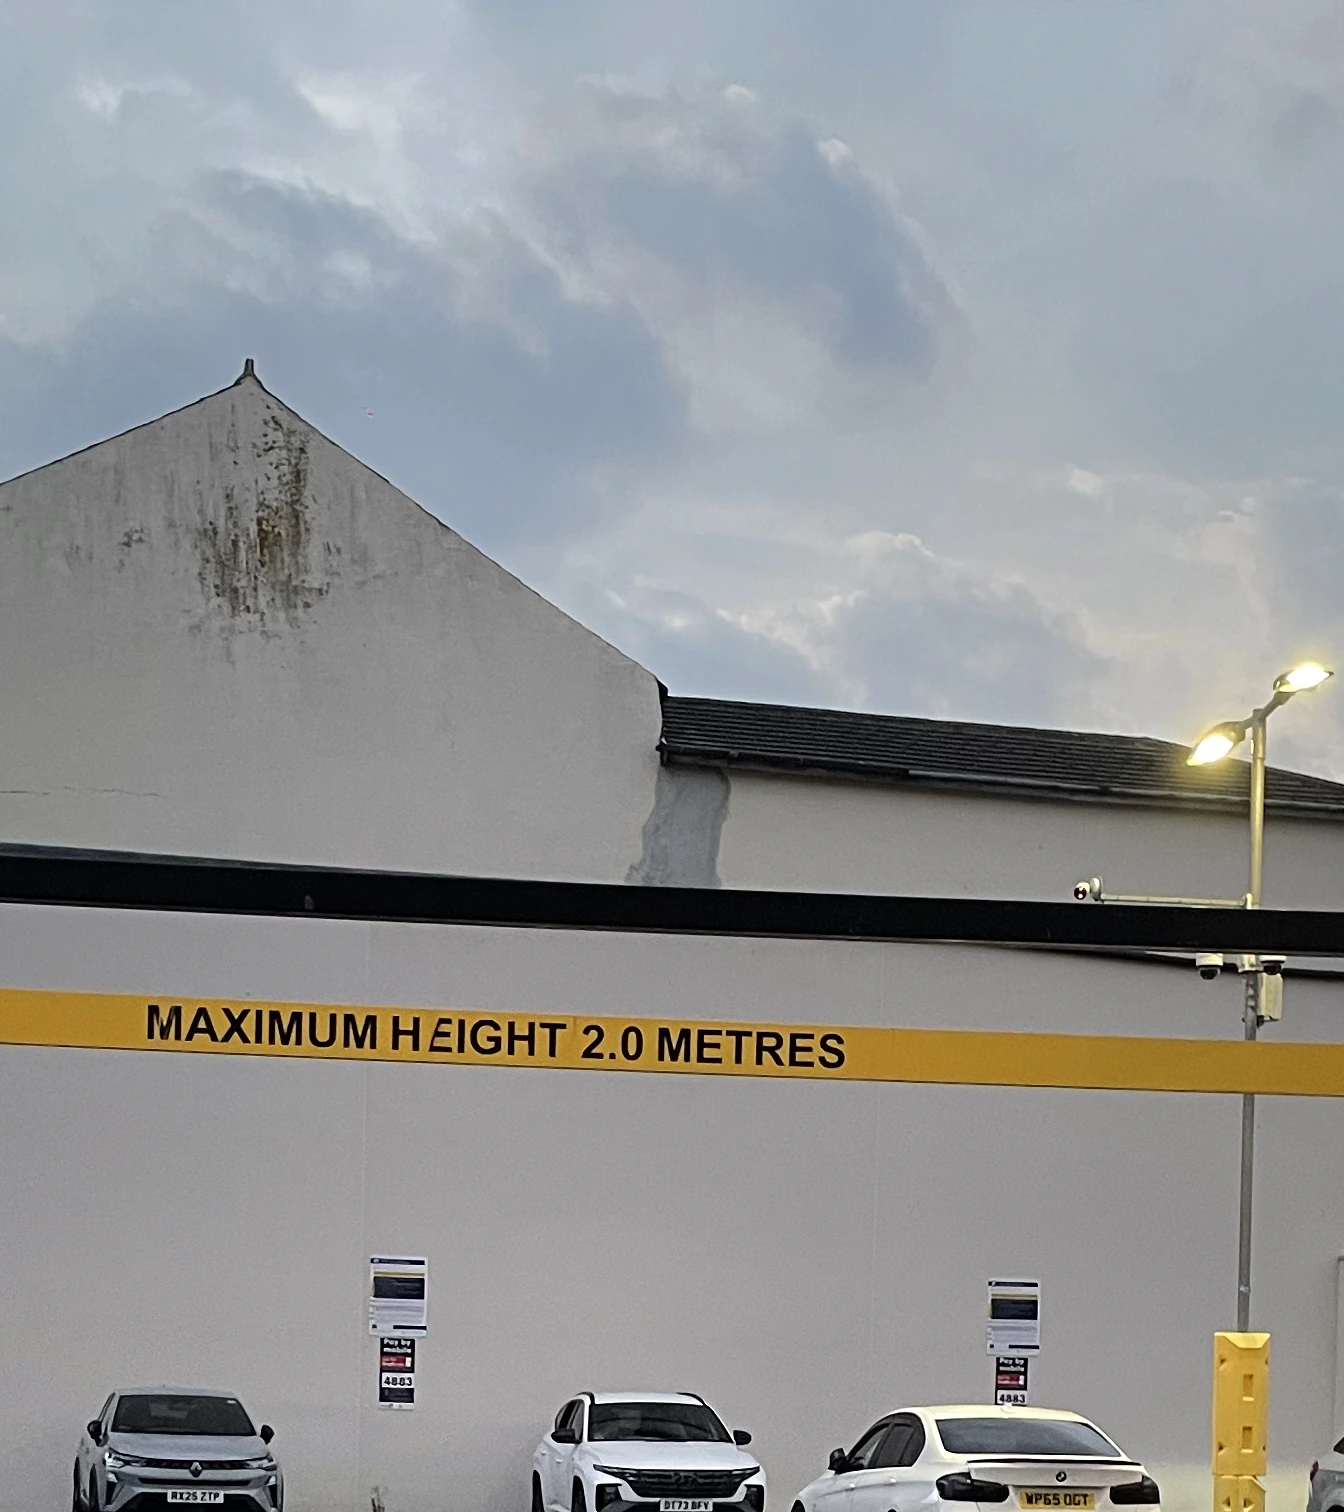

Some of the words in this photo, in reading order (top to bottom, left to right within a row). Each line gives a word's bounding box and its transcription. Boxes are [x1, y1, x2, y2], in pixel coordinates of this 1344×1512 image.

[146, 1003, 378, 1050] MAXIMUM
[391, 1014, 568, 1058] HEIGHT
[581, 1023, 644, 1062] 2.0
[657, 1026, 846, 1069] METRES
